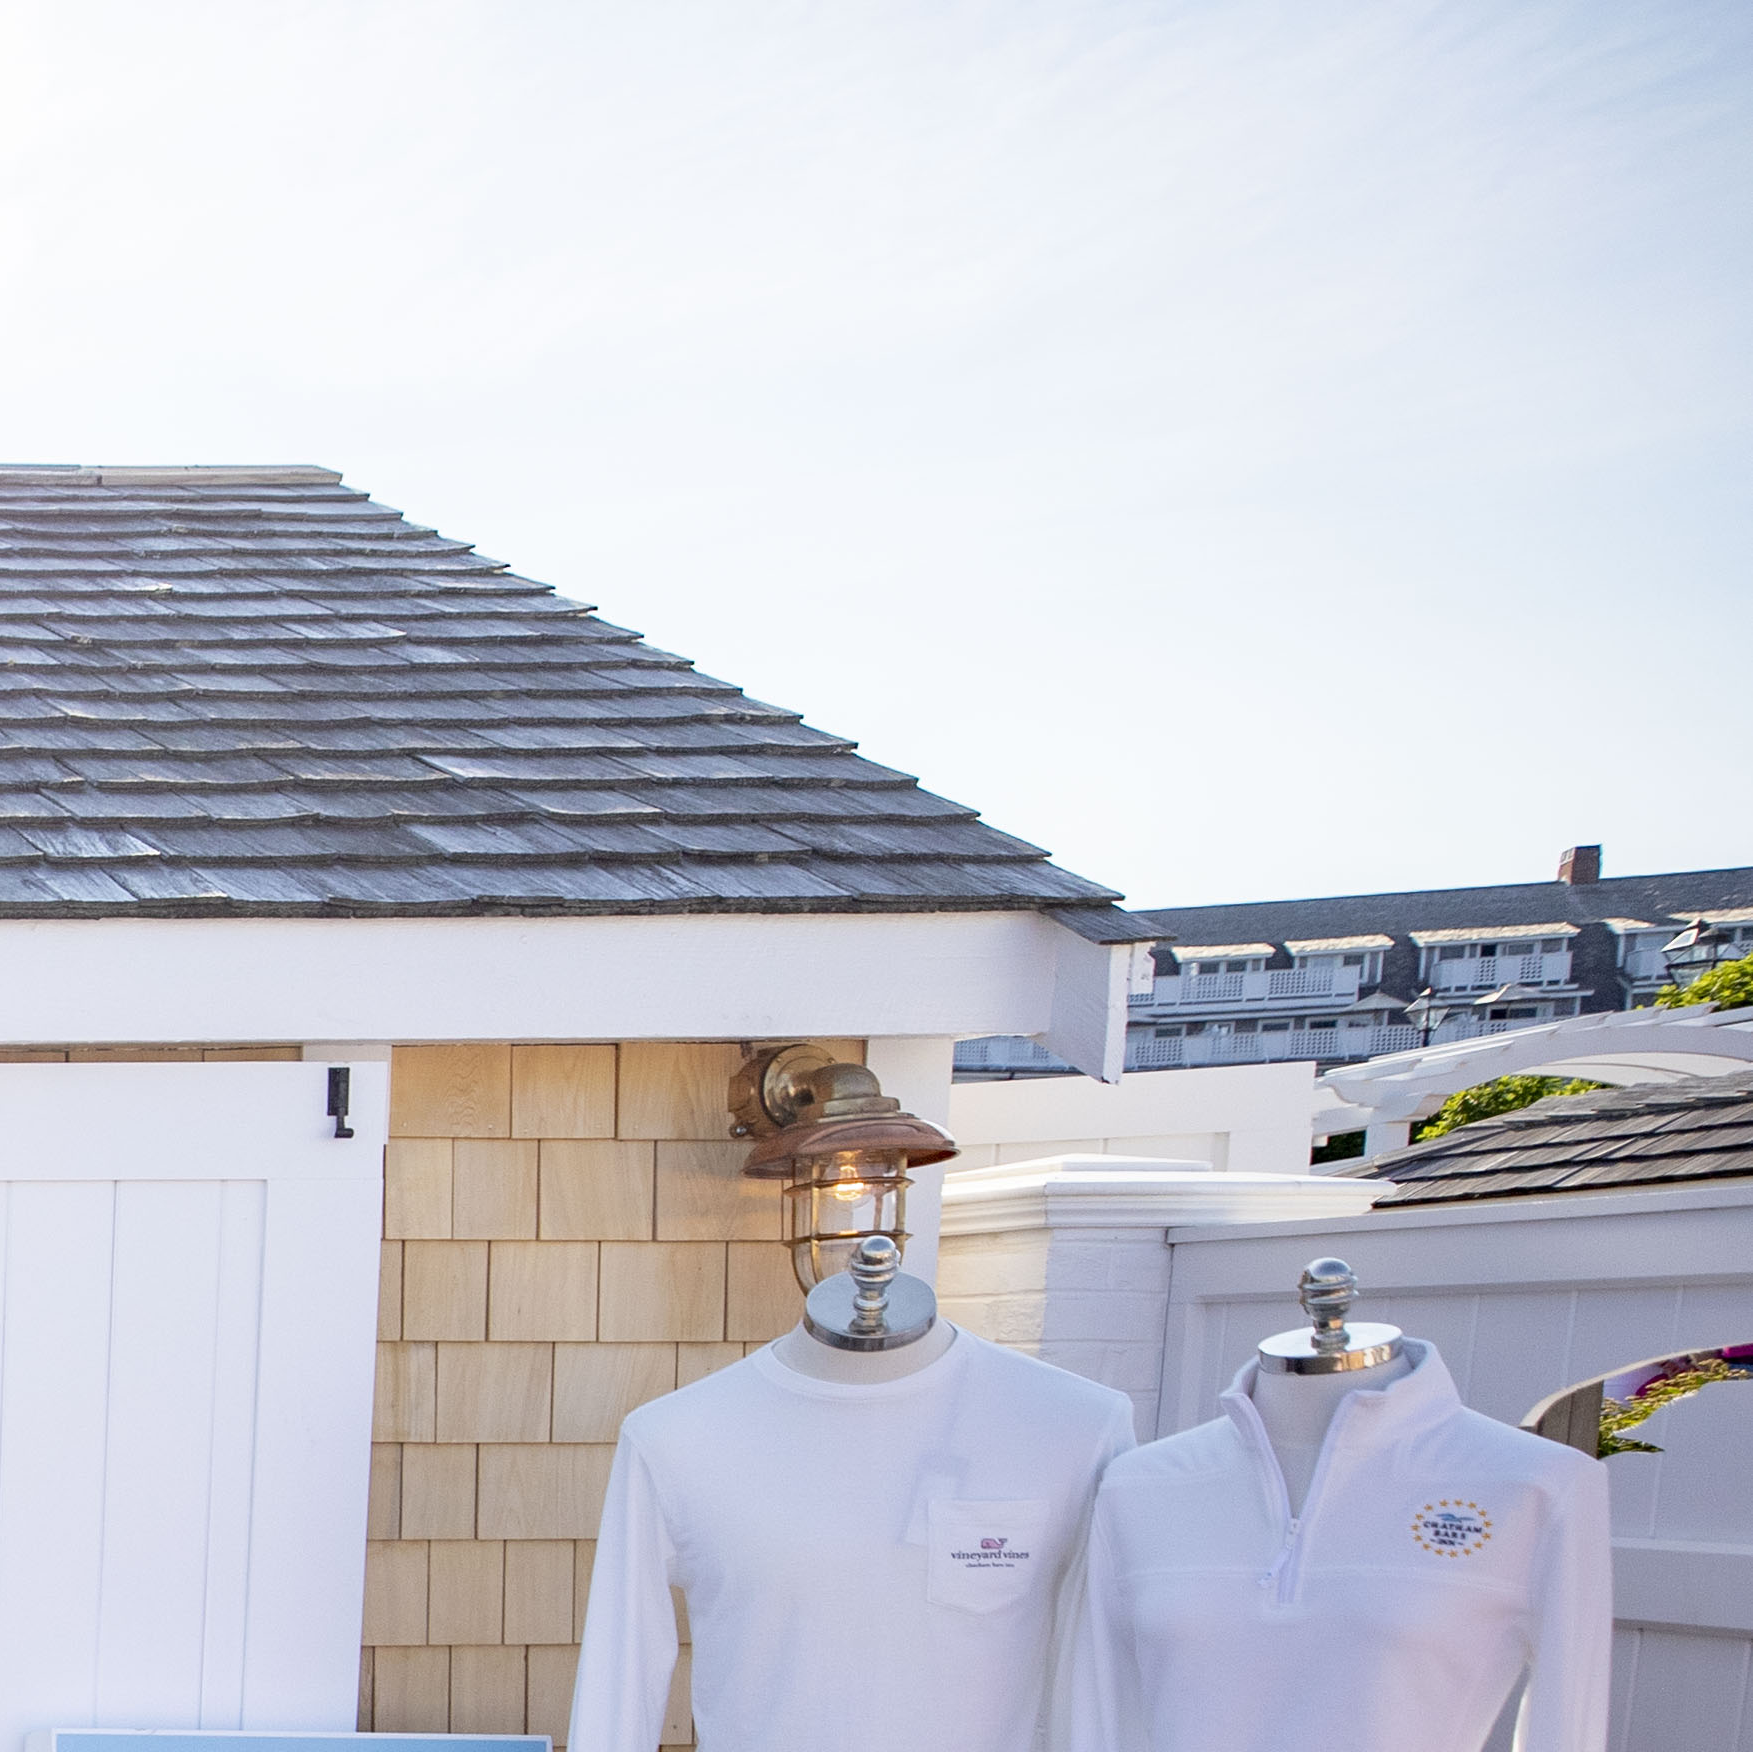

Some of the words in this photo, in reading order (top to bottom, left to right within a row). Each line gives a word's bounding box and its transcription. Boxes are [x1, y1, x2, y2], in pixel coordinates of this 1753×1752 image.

[1423, 1520, 1483, 1534] CHATHAM
[1433, 1529, 1467, 1541] BARS
[951, 1549, 1002, 1562] vineyard
[1003, 1550, 1030, 1560] vines
